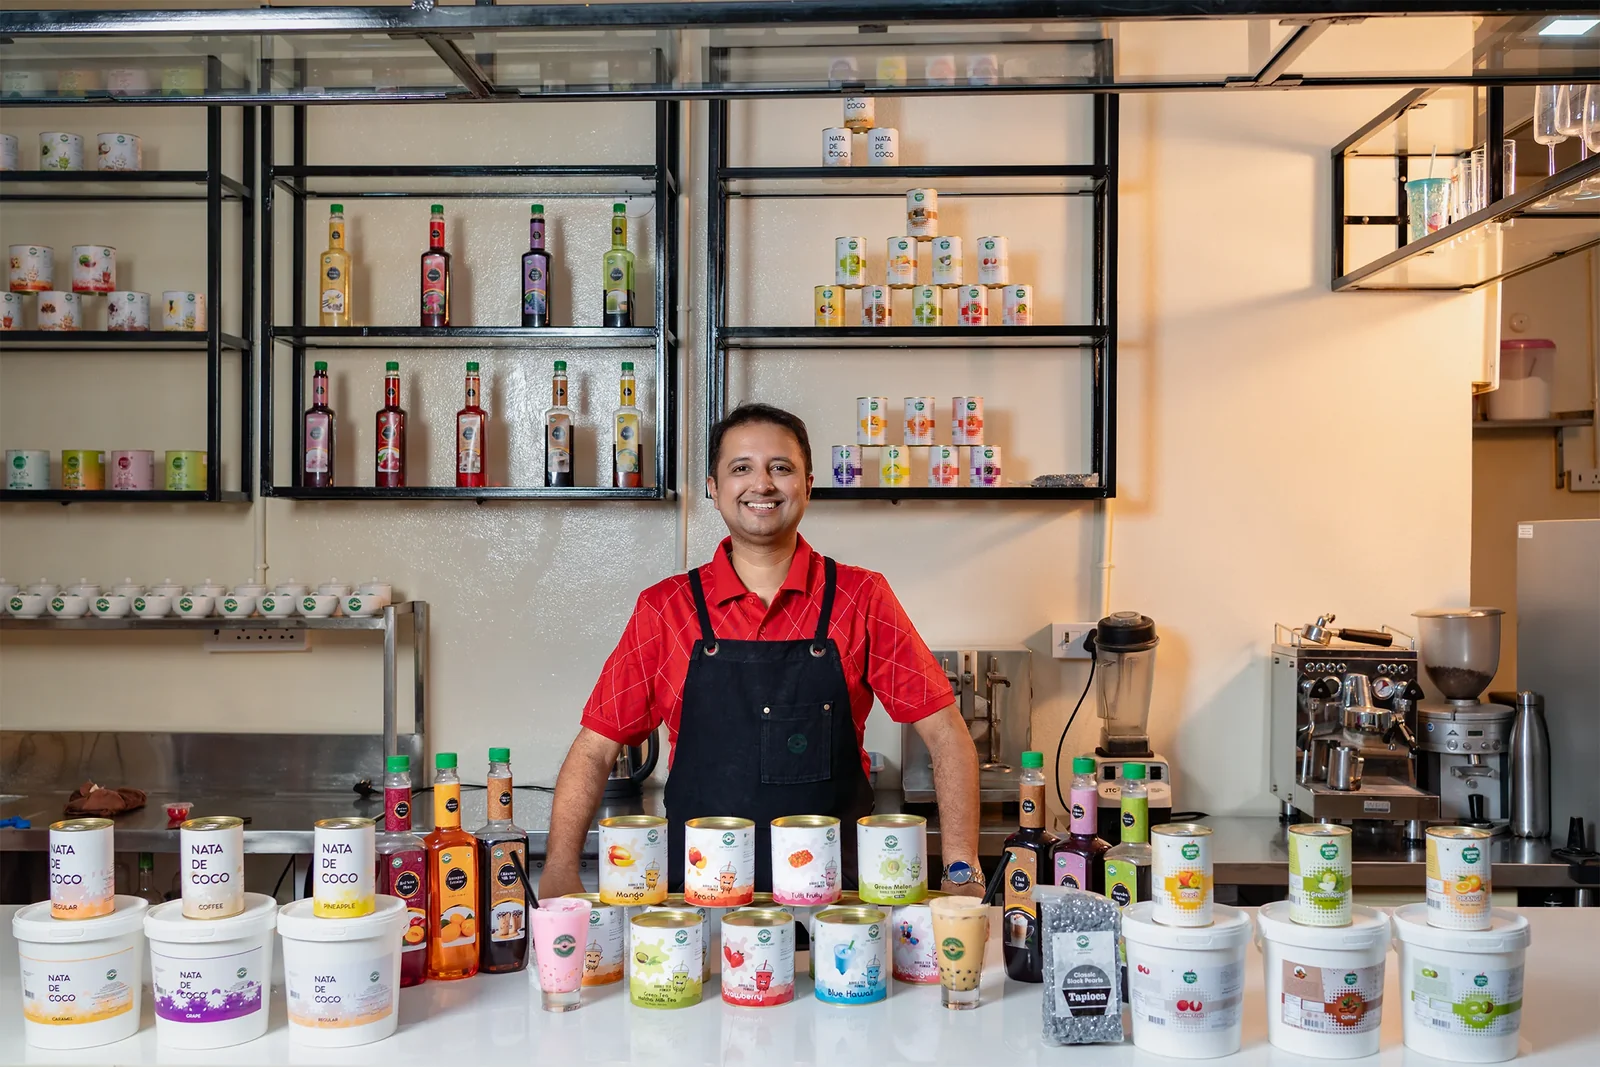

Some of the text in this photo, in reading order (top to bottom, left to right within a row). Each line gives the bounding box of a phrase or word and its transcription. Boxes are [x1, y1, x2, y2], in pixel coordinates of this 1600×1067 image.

[50, 844, 75, 855] NATA
[192, 844, 223, 854] NATA
[322, 844, 352, 854] NATA
[192, 860, 207, 870] DE
[322, 858, 336, 868] DE
[52, 873, 82, 885] COCO
[192, 872, 230, 884] COCO
[322, 873, 358, 884] COCO
[616, 891, 644, 900] Mango
[694, 891, 716, 900] Peach
[828, 988, 843, 997] Blue
[1068, 992, 1106, 1003] Tapioca
